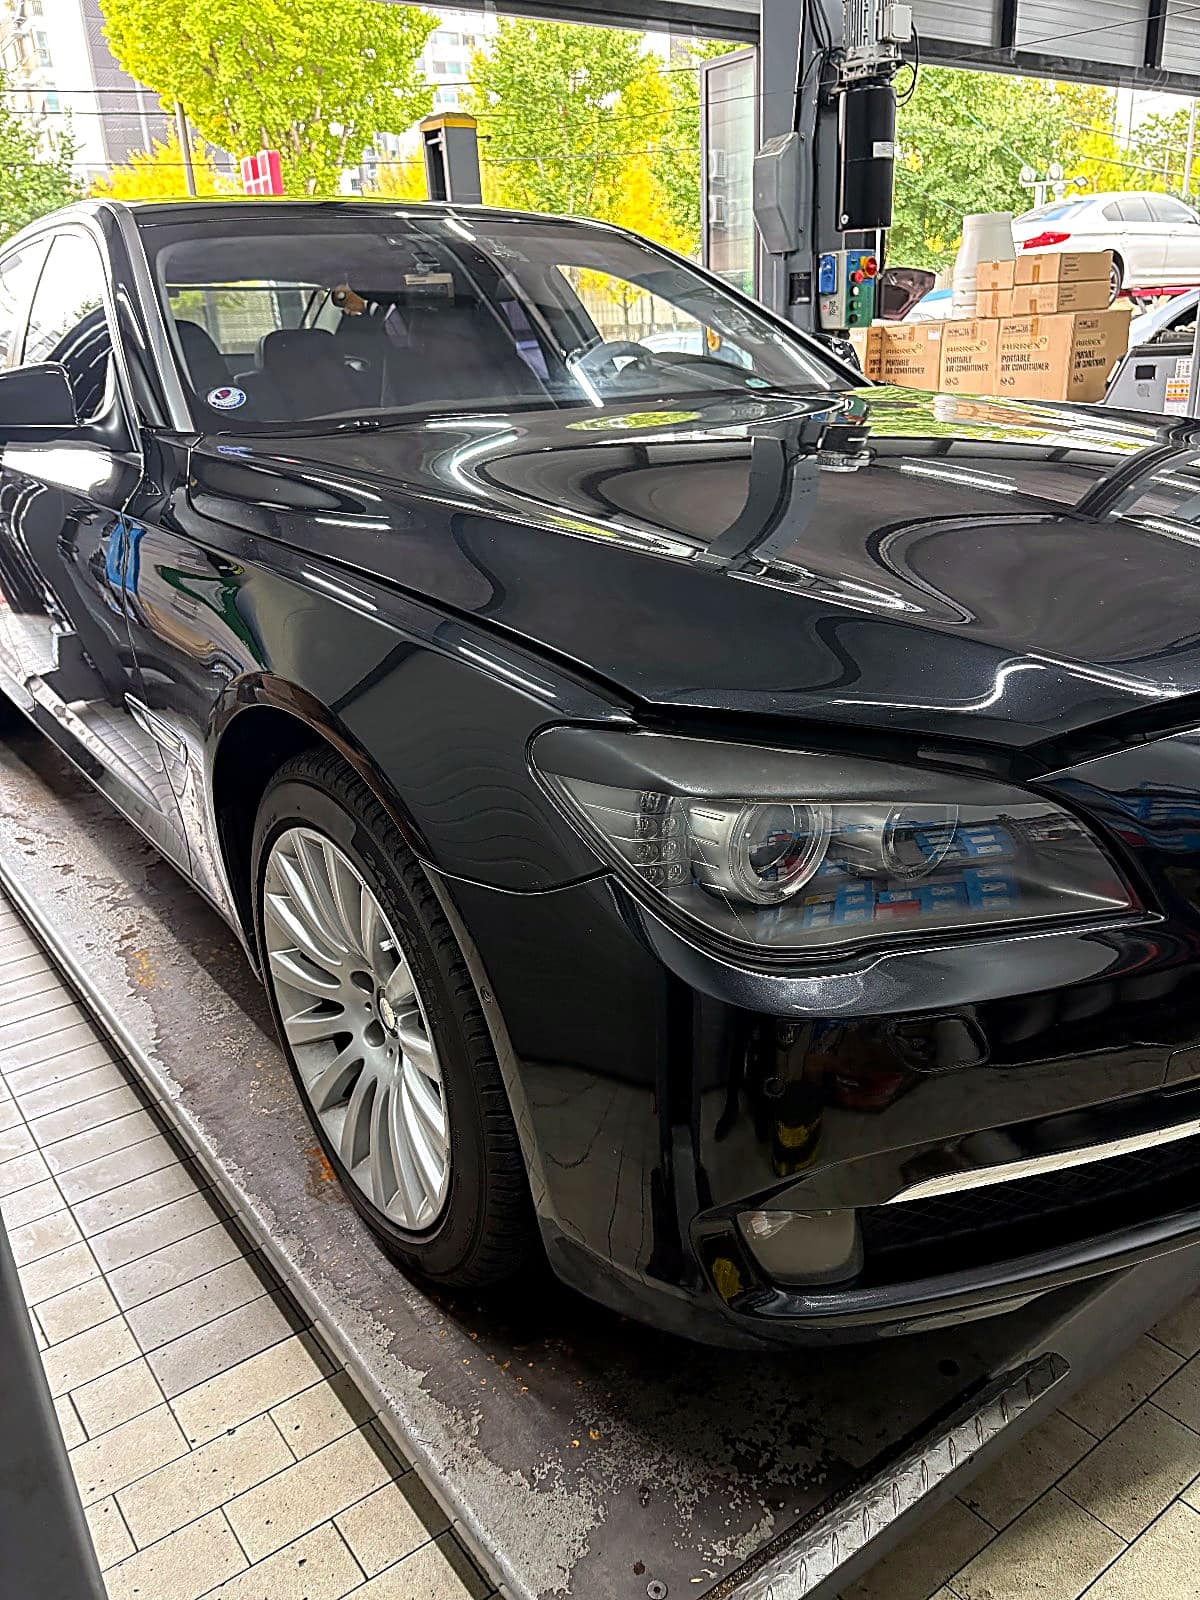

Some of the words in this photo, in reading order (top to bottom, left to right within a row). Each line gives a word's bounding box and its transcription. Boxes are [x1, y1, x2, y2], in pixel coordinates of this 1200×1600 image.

[945, 355, 971, 364] PORTABLE
[1001, 353, 1030, 363] PORTABLE
[894, 367, 925, 375] CONDITIONER
[946, 364, 954, 373] AIR
[955, 363, 989, 373] CONDITIONER
[1001, 363, 1010, 372] AIR
[1012, 362, 1050, 371] CONDITIONER
